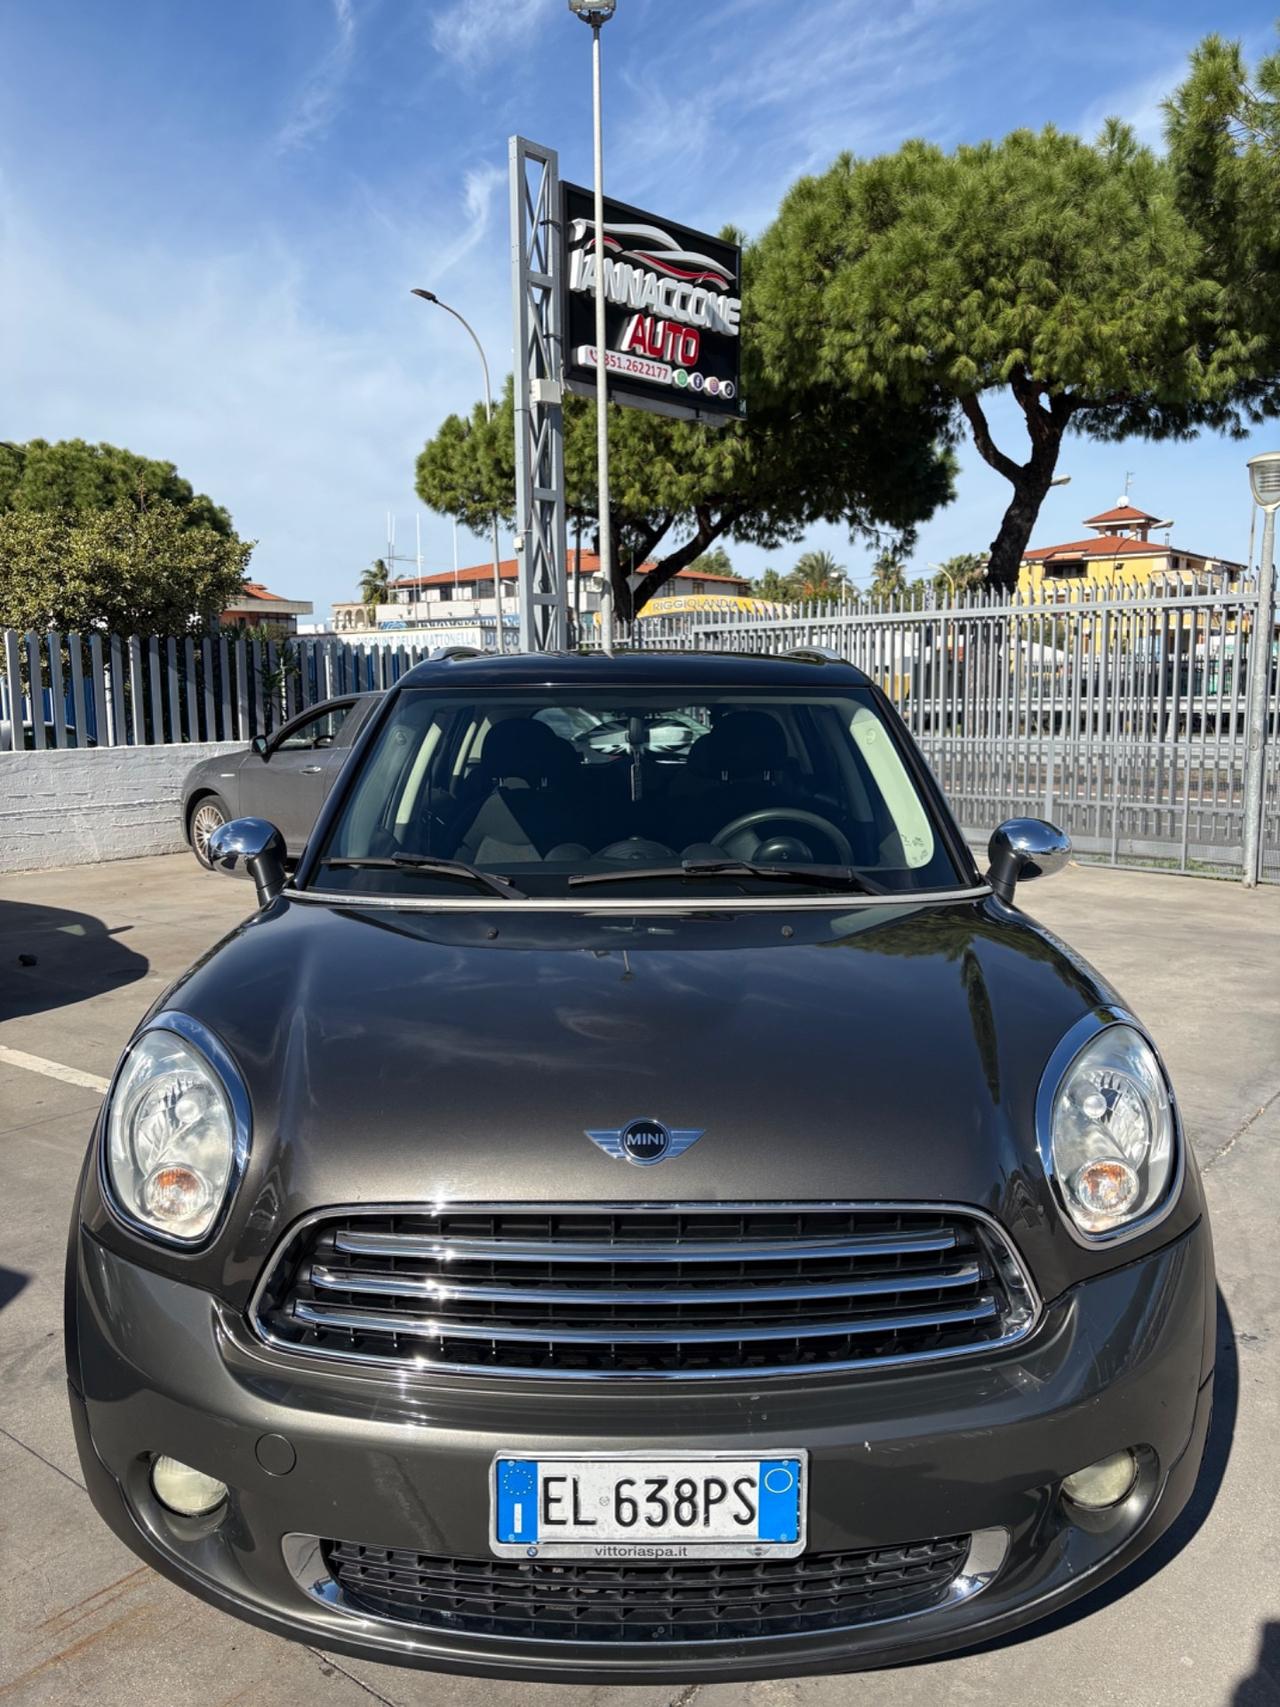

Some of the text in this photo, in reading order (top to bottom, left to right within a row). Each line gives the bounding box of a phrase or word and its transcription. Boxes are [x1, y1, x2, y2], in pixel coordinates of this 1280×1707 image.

[570, 248, 742, 336] IANNACCONE
[621, 314, 700, 367] AUTO
[627, 1133, 665, 1146] MINI
[542, 1476, 758, 1528] EL 638PS
[594, 1546, 688, 1559] vittoriaspa.it
